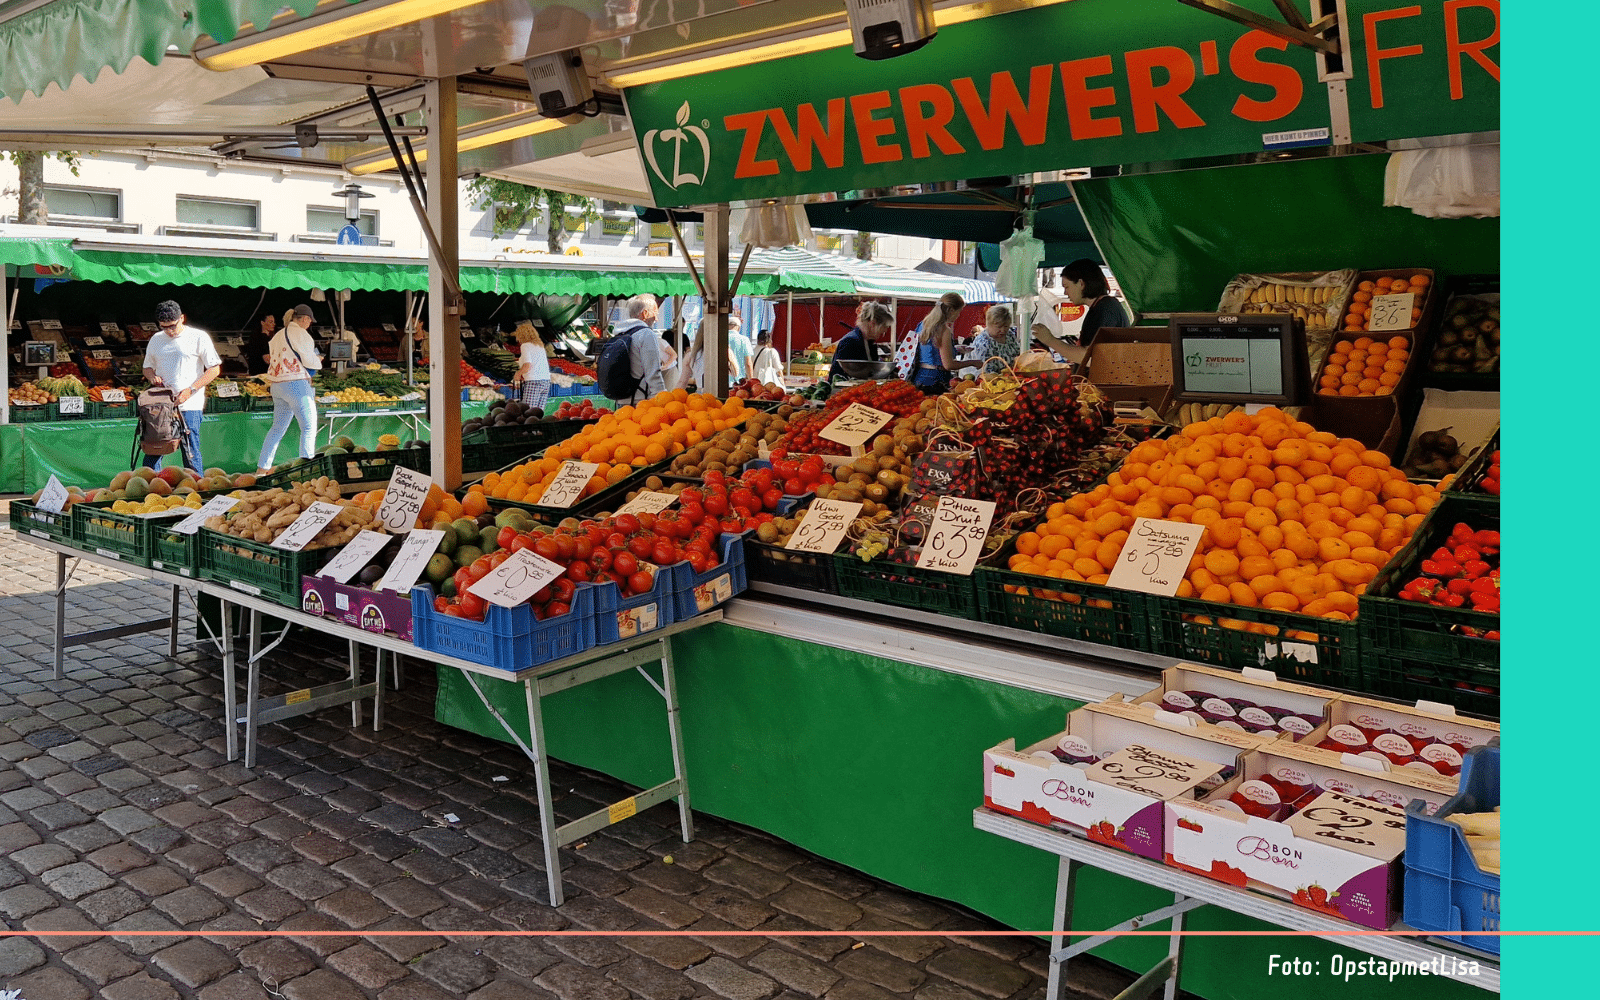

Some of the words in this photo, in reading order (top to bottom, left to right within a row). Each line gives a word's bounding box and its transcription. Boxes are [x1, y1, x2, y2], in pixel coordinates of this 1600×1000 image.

[724, 29, 1304, 179] ZWERWER'S
[1303, 130, 1327, 139] PINNEN
[928, 468, 952, 480] EXSA
[1137, 520, 1190, 542] Satsuma
[364, 617, 374, 626] EAT
[374, 618, 382, 628] ME
